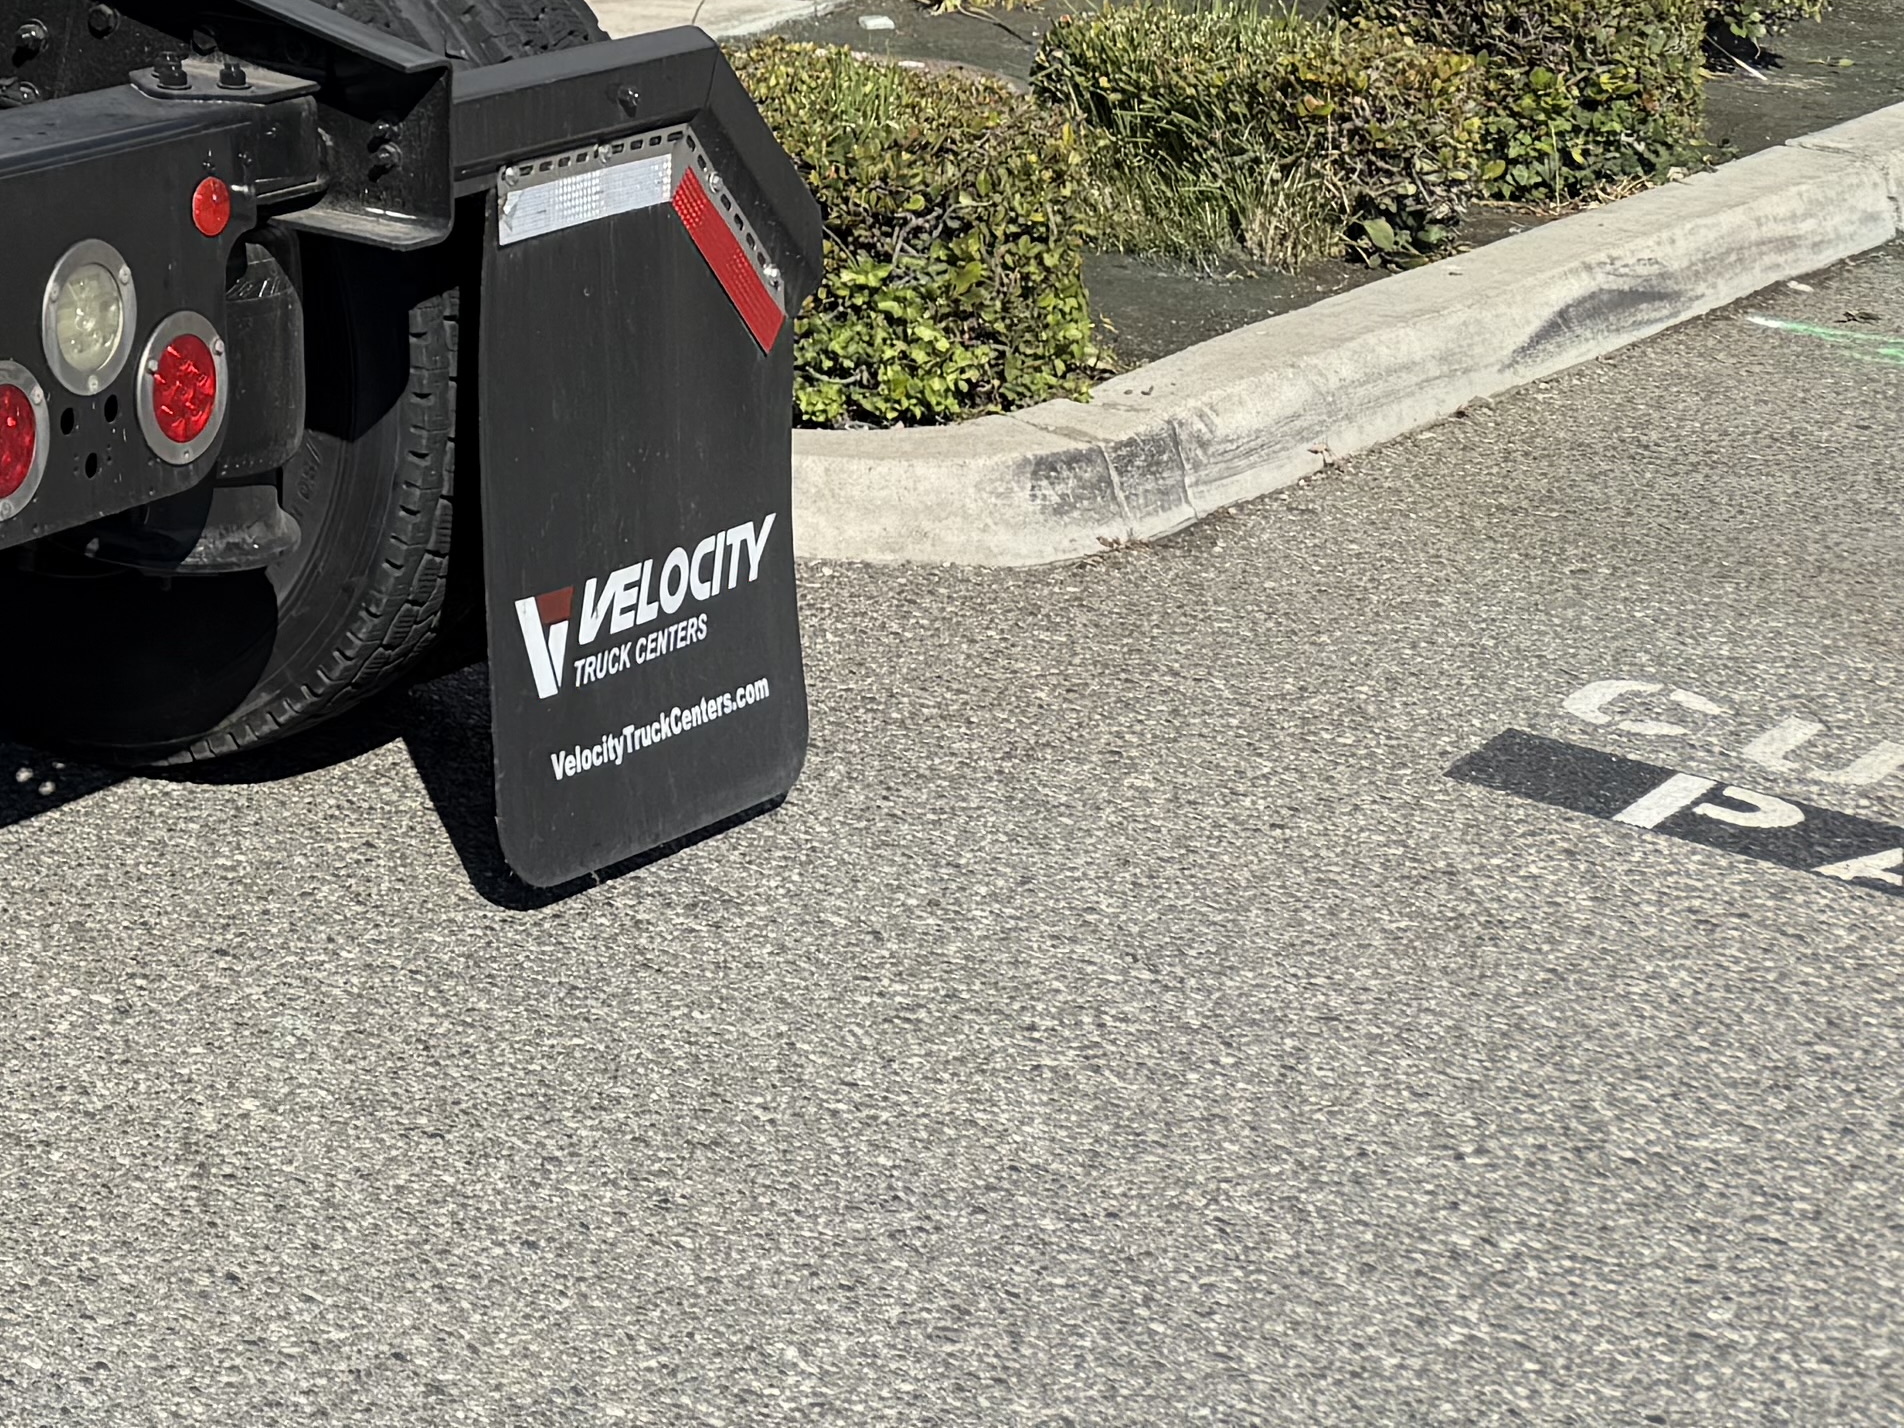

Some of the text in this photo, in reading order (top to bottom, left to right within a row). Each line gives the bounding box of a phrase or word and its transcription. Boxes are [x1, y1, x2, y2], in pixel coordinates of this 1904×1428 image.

[578, 512, 777, 646] VELOCITY
[573, 612, 708, 688] TRUCK CENTERS
[550, 677, 770, 781] VelocityTruckCenters.com
